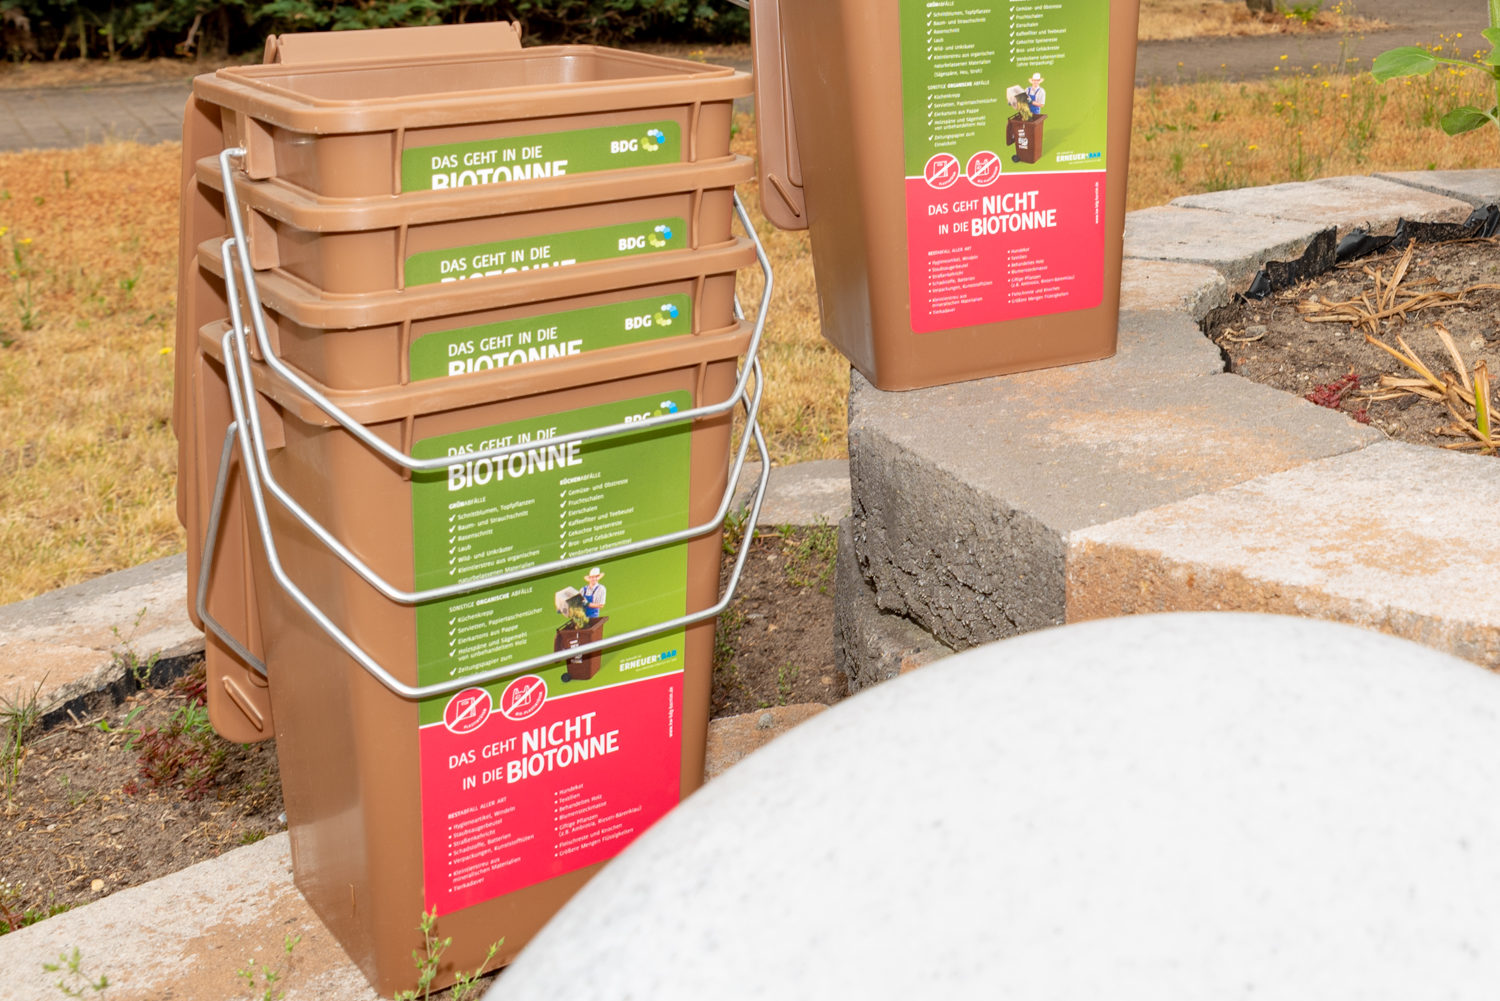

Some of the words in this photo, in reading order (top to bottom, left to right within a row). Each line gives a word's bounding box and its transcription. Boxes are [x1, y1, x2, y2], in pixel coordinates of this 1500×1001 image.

[432, 154, 458, 170] DAS
[464, 150, 498, 166] GEHT
[503, 149, 516, 162] IN
[522, 146, 543, 160] DIE
[611, 139, 638, 154] BDG
[929, 203, 949, 216] DAS
[953, 199, 979, 213] GEHT
[983, 191, 1039, 216] NICHT
[939, 224, 949, 235] IN
[953, 221, 969, 233] DIE
[972, 209, 1057, 237] BIOTONNE
[619, 236, 646, 251] BDG
[441, 258, 467, 274] DAS
[473, 252, 506, 269] GEHT
[512, 250, 524, 263] IN
[530, 246, 551, 261] DIE
[625, 315, 652, 331] BDG
[449, 341, 475, 357] DAS
[480, 334, 513, 352] GEHT
[519, 331, 531, 345] IN
[538, 327, 558, 342] DIE
[448, 444, 474, 457] DAS
[480, 435, 513, 451] GEHT
[518, 432, 531, 445] IN
[537, 427, 558, 442] DIE
[448, 440, 583, 492] BIOTONNE
[449, 750, 476, 769] DAS
[482, 737, 517, 759] GEHT
[522, 712, 596, 755] NICHT
[463, 775, 476, 790] IN
[483, 767, 503, 784] DIE
[507, 730, 619, 784] BIOTONNE
